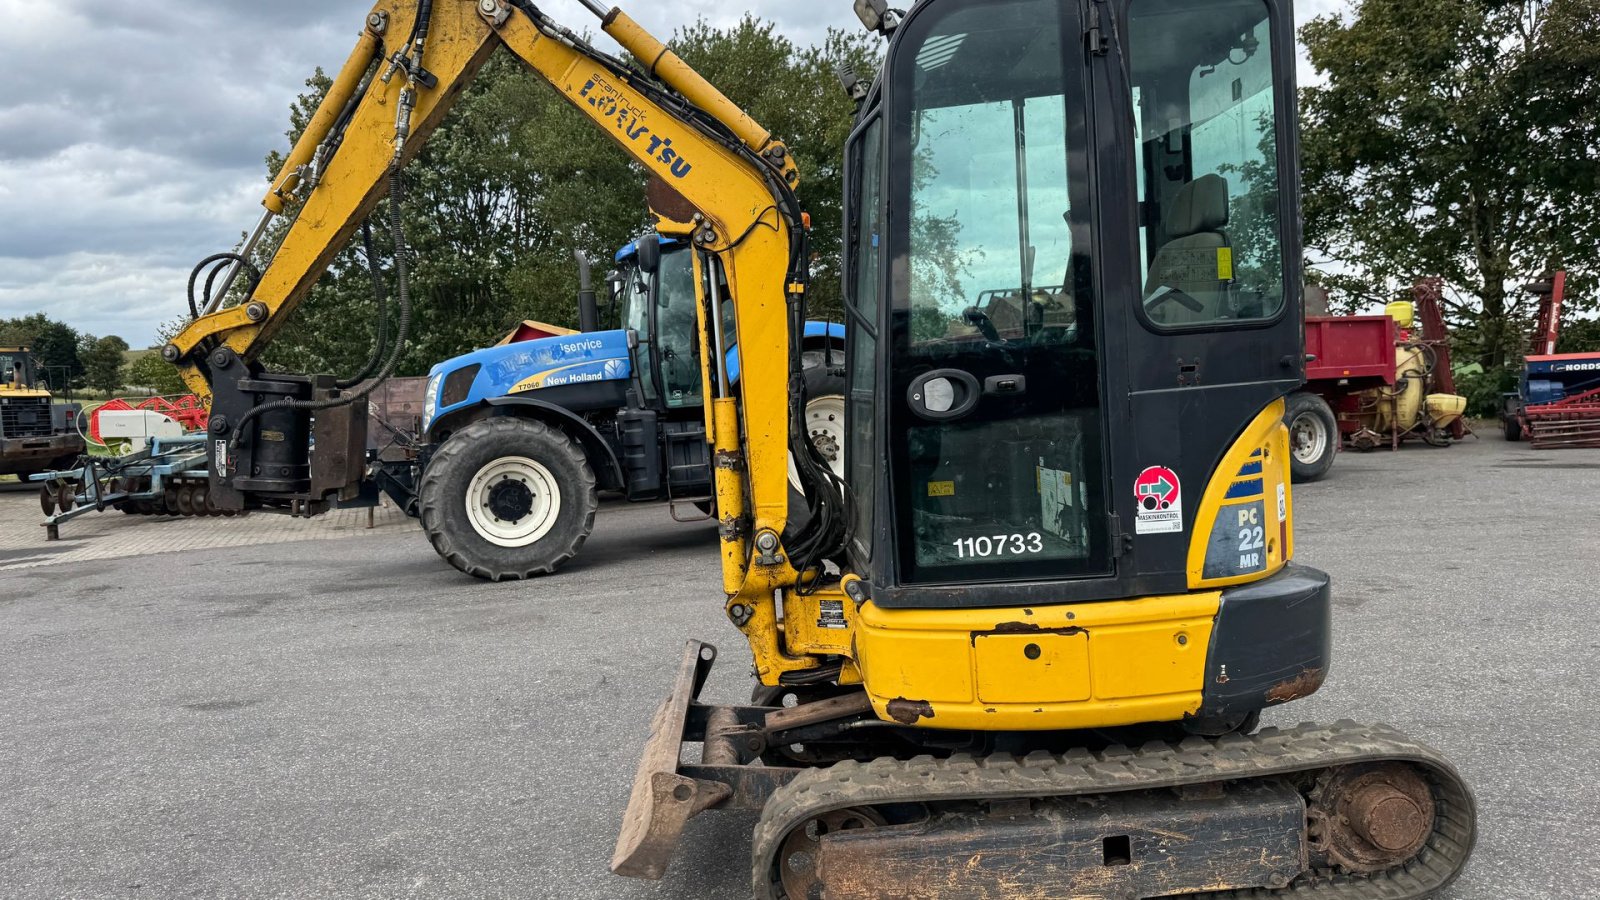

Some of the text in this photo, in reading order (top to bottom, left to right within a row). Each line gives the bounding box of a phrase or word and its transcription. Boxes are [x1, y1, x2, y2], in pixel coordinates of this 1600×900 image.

[591, 73, 648, 122] scantruck
[518, 382, 540, 391] T7060
[547, 372, 603, 386] New Holland
[1238, 508, 1258, 526] PC
[952, 532, 1043, 558] 110733
[1238, 526, 1264, 551] 22
[1240, 553, 1260, 568] MR
